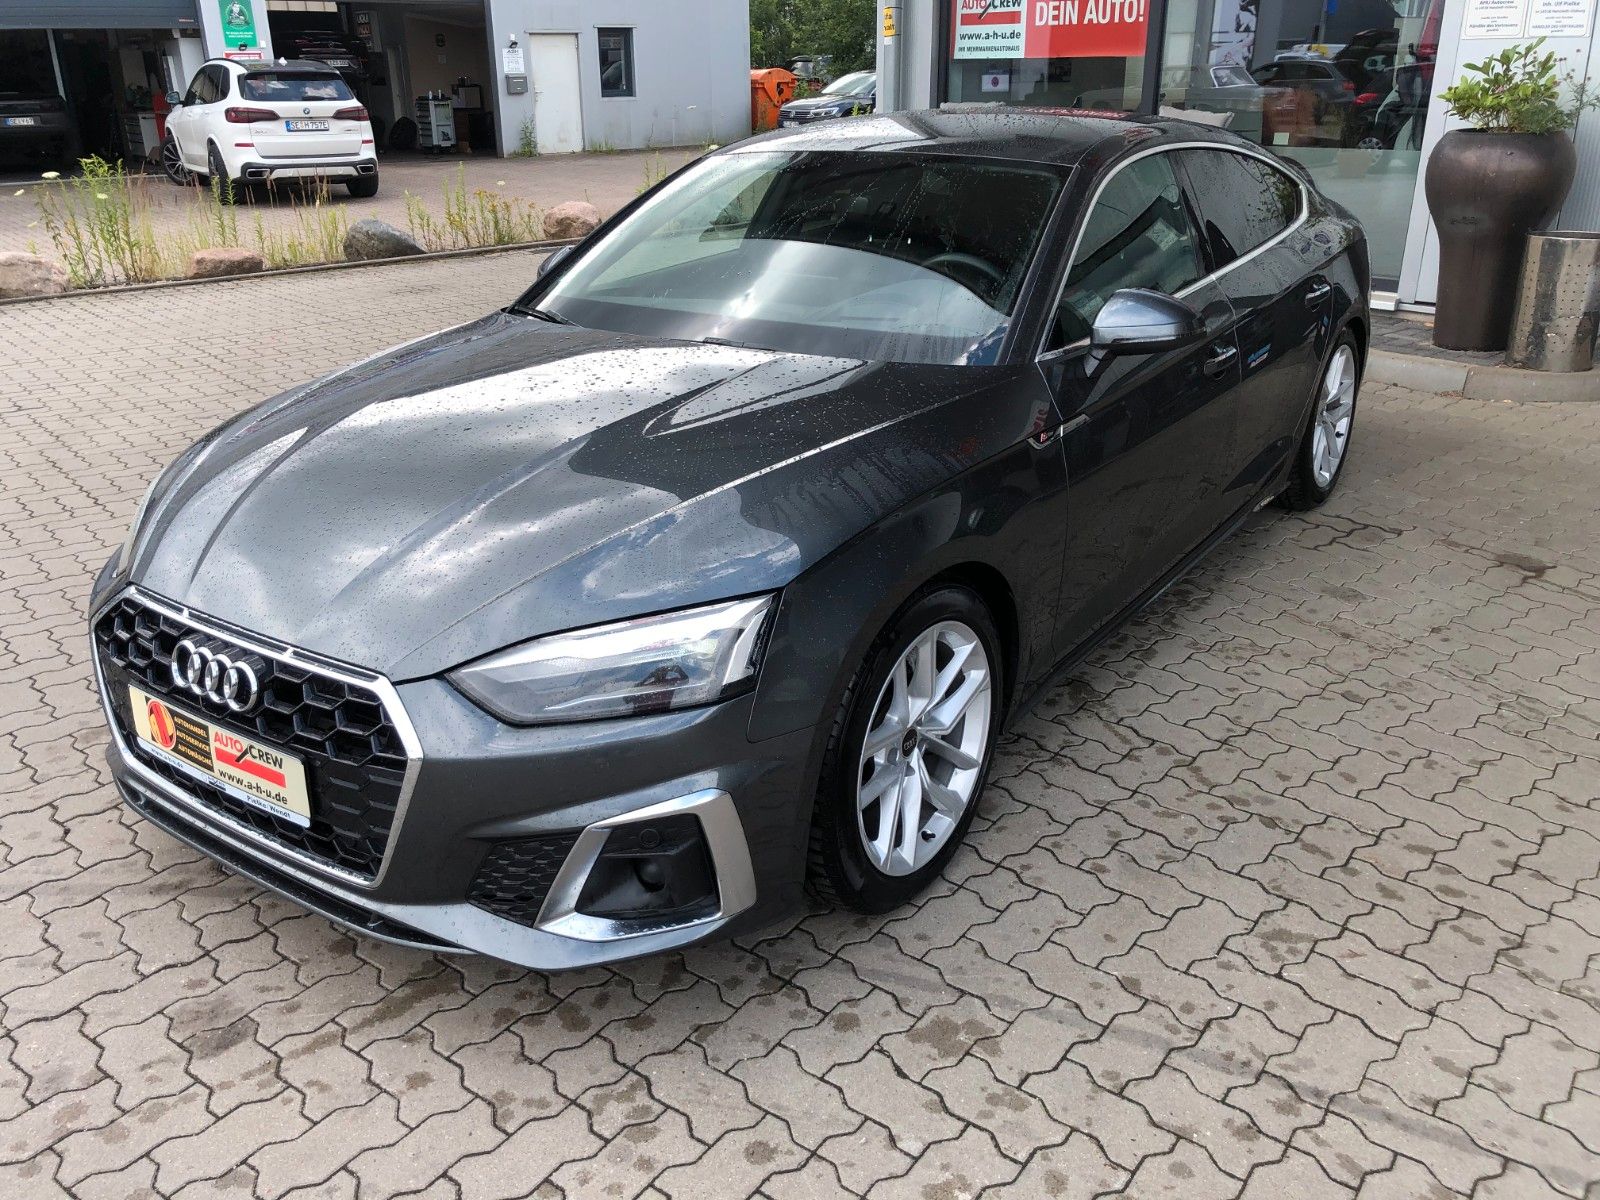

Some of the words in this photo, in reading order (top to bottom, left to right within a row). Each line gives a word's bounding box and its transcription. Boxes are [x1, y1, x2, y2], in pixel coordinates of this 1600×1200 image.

[961, 0, 987, 10] AUTO
[992, 0, 1022, 9] CREW
[1035, 0, 1078, 26] DEIN
[1083, 0, 1145, 24] AUTO!
[960, 30, 1021, 41] www.a-h-u.de
[173, 716, 207, 738] AUTOHANDEL
[176, 730, 210, 752] AUTOSERVICE
[213, 731, 243, 752] AUTO
[248, 744, 283, 769] CREW
[218, 768, 288, 804] www.a-h-u.de
